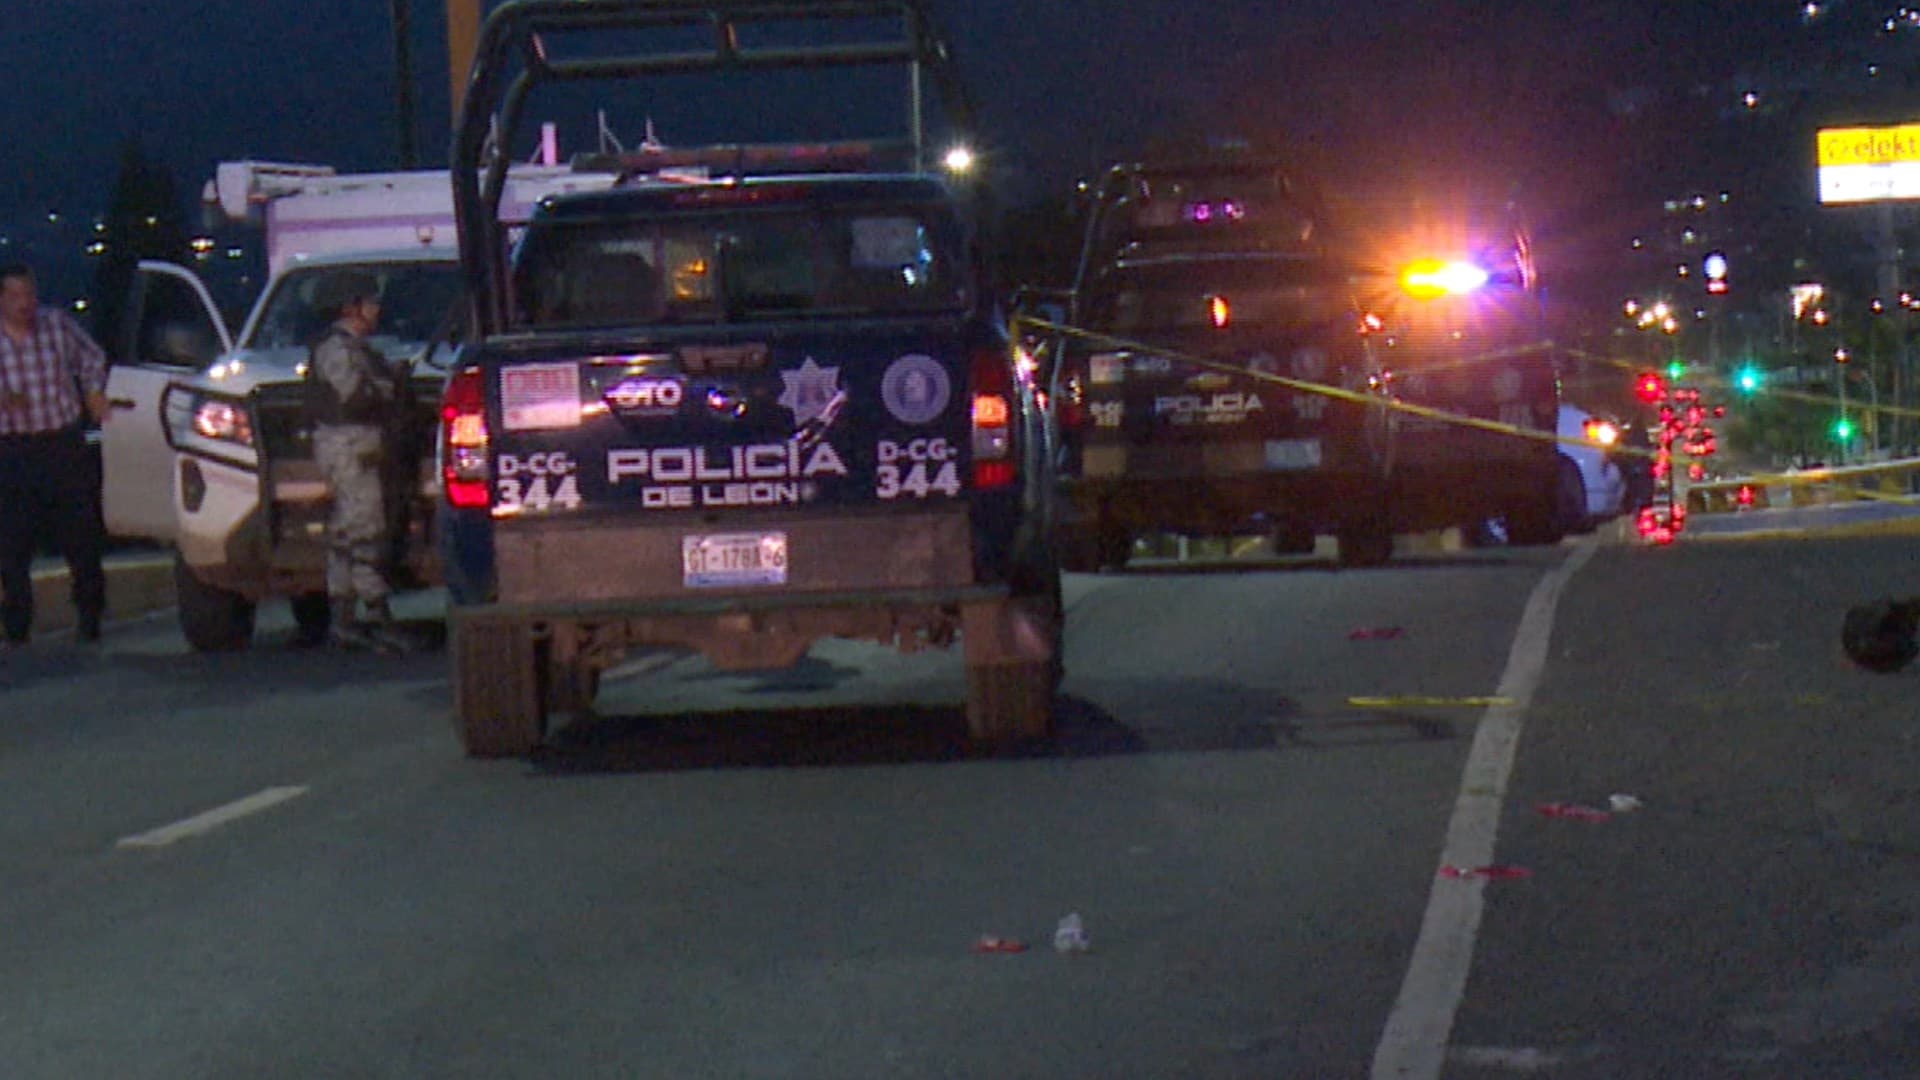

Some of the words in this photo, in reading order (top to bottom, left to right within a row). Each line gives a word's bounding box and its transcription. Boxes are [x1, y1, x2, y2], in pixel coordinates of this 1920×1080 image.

[878, 437, 958, 461] D-CG-
[498, 452, 577, 476] D-CG-
[876, 461, 961, 498] 344
[498, 475, 582, 512] 344
[642, 486, 693, 508] DE
